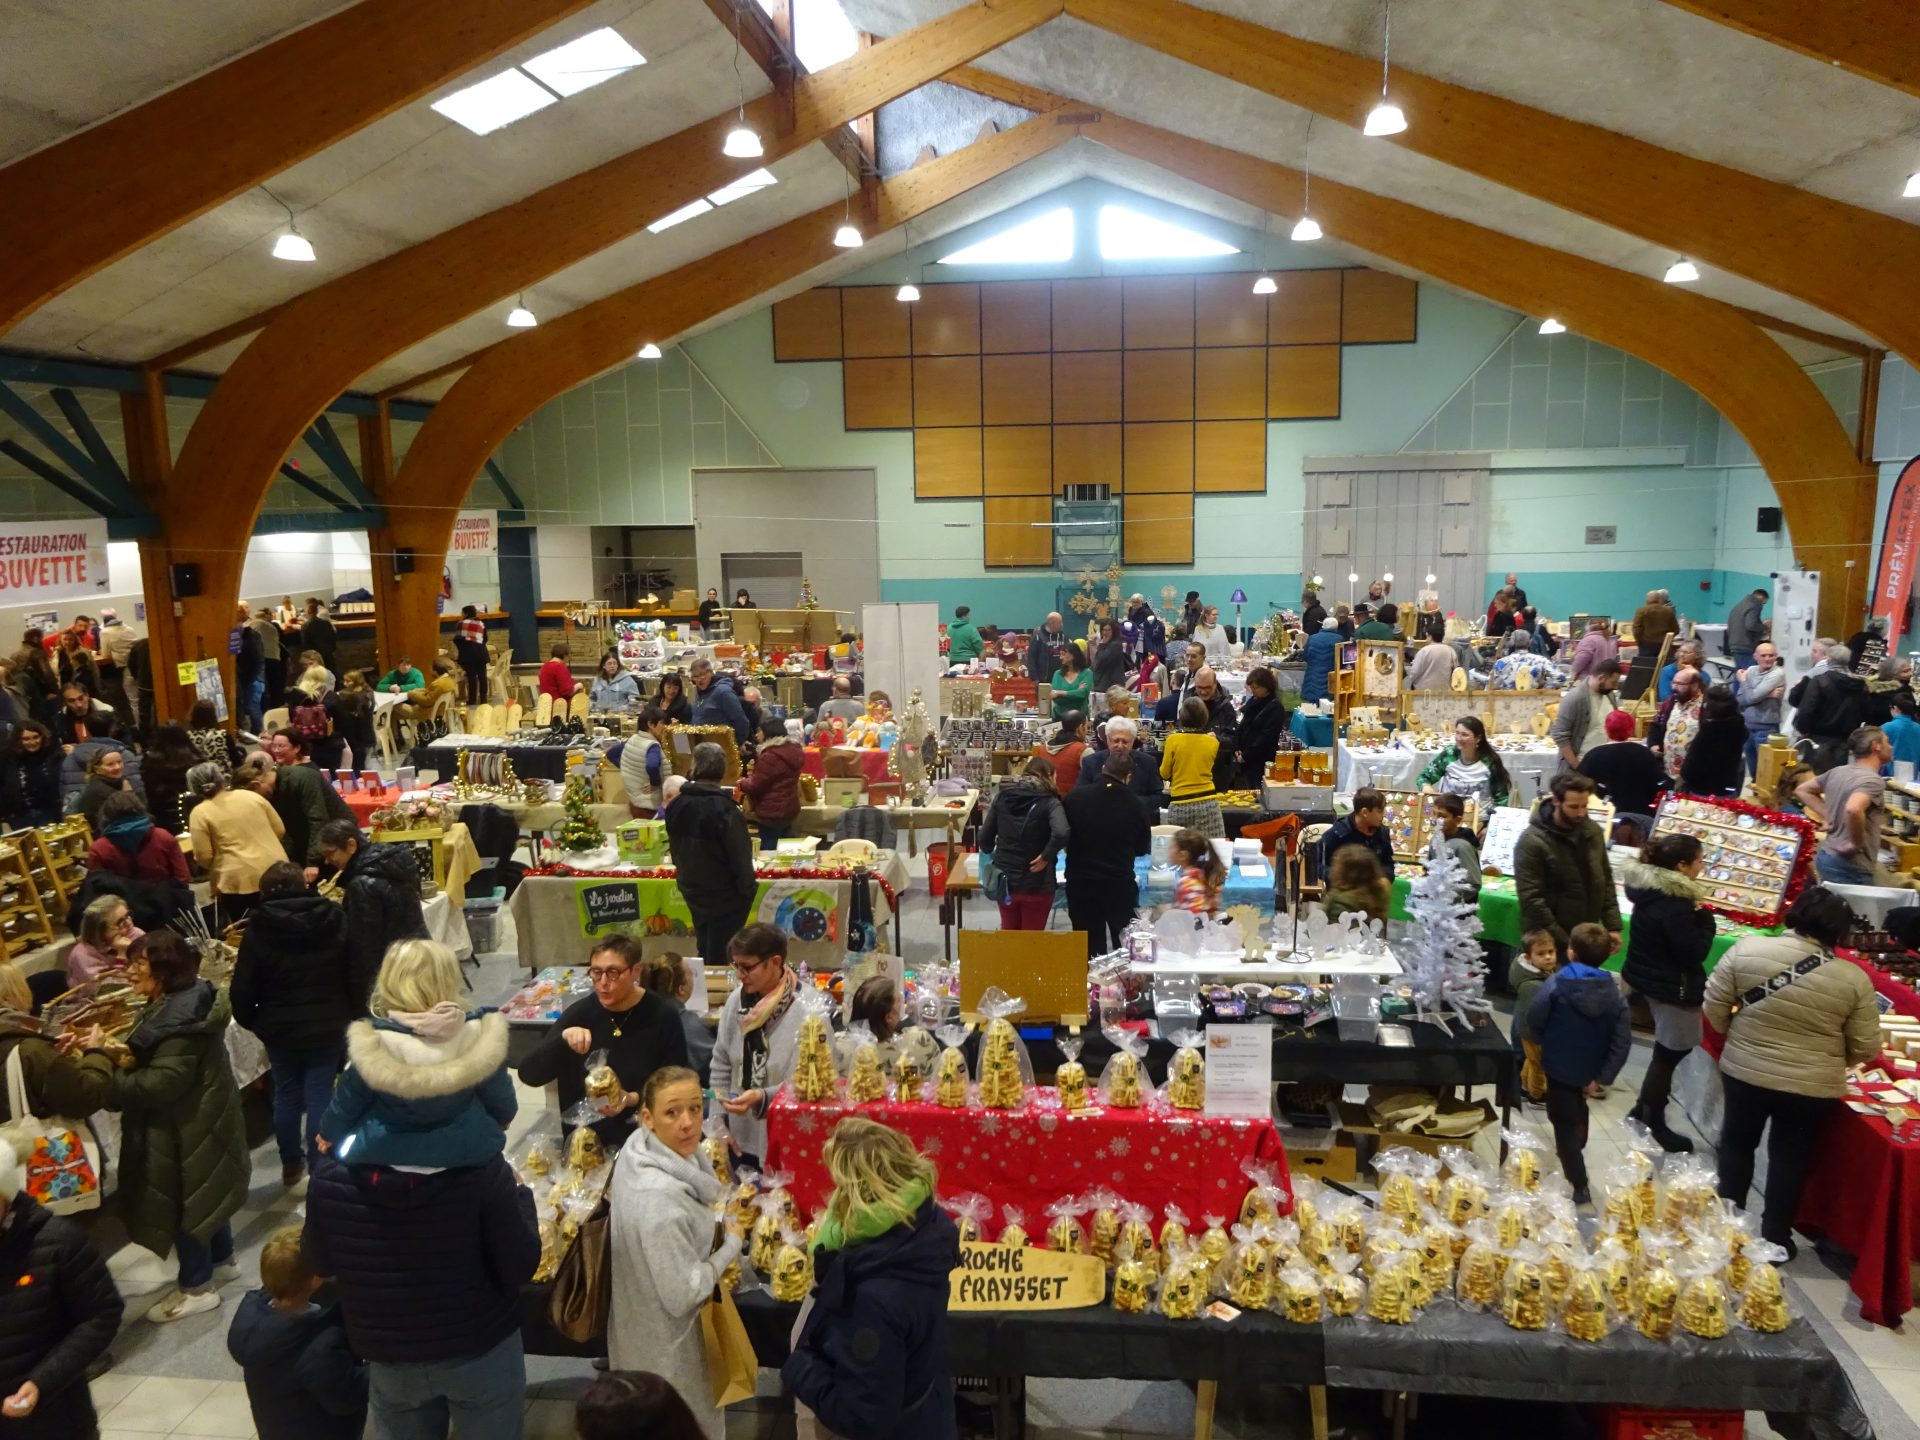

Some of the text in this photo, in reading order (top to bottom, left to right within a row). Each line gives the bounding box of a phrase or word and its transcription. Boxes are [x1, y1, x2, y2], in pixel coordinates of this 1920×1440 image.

[456, 518, 490, 530] ESTAURATION
[0, 533, 86, 555] ESTAURATION
[455, 531, 489, 550] BUVETTE
[0, 555, 86, 590] BUVETTE
[589, 888, 635, 910] Le jardin
[961, 1247, 1023, 1273] ROCHE
[960, 1275, 1068, 1302] FRAYSSET
